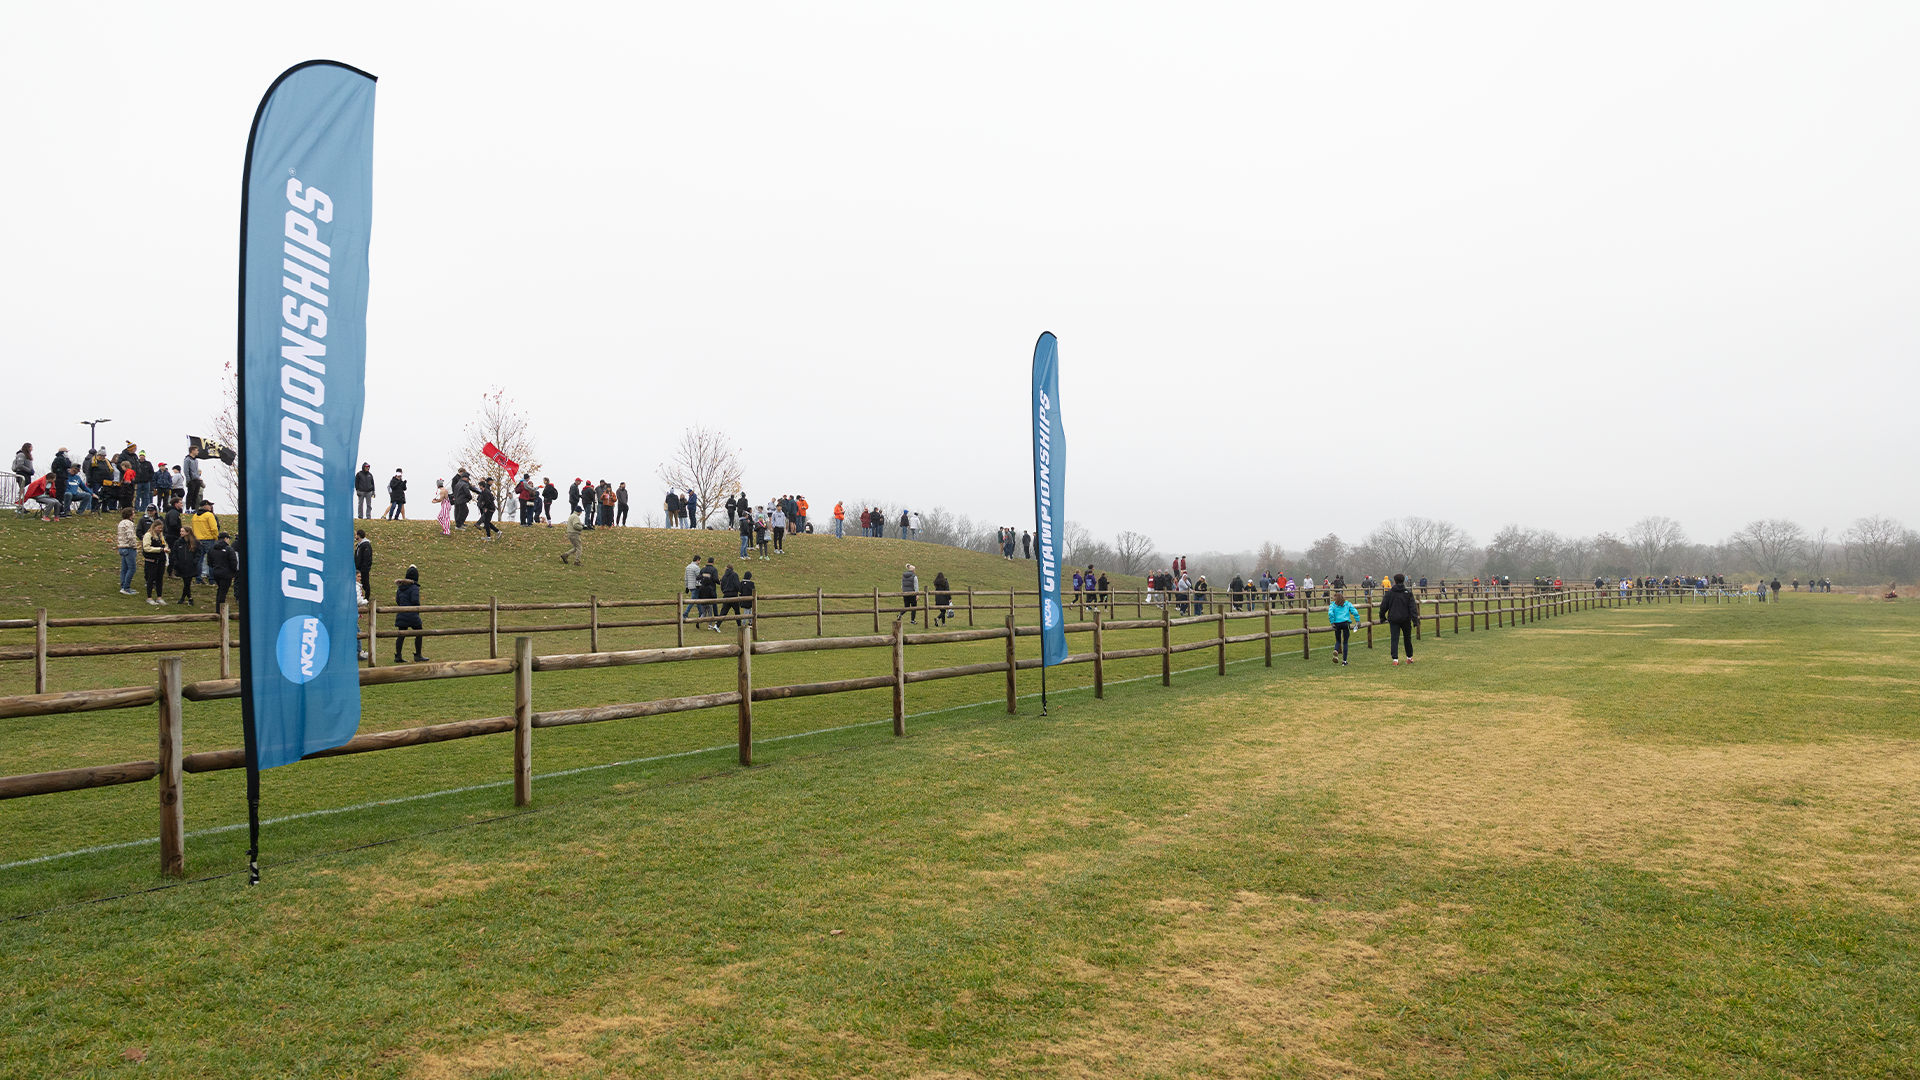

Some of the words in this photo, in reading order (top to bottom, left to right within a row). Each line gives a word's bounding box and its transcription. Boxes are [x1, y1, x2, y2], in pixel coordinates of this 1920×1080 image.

[281, 177, 333, 604] CHAMPIONSHIPS
[1044, 598, 1052, 628] NCAA
[300, 618, 319, 677] NCAA
